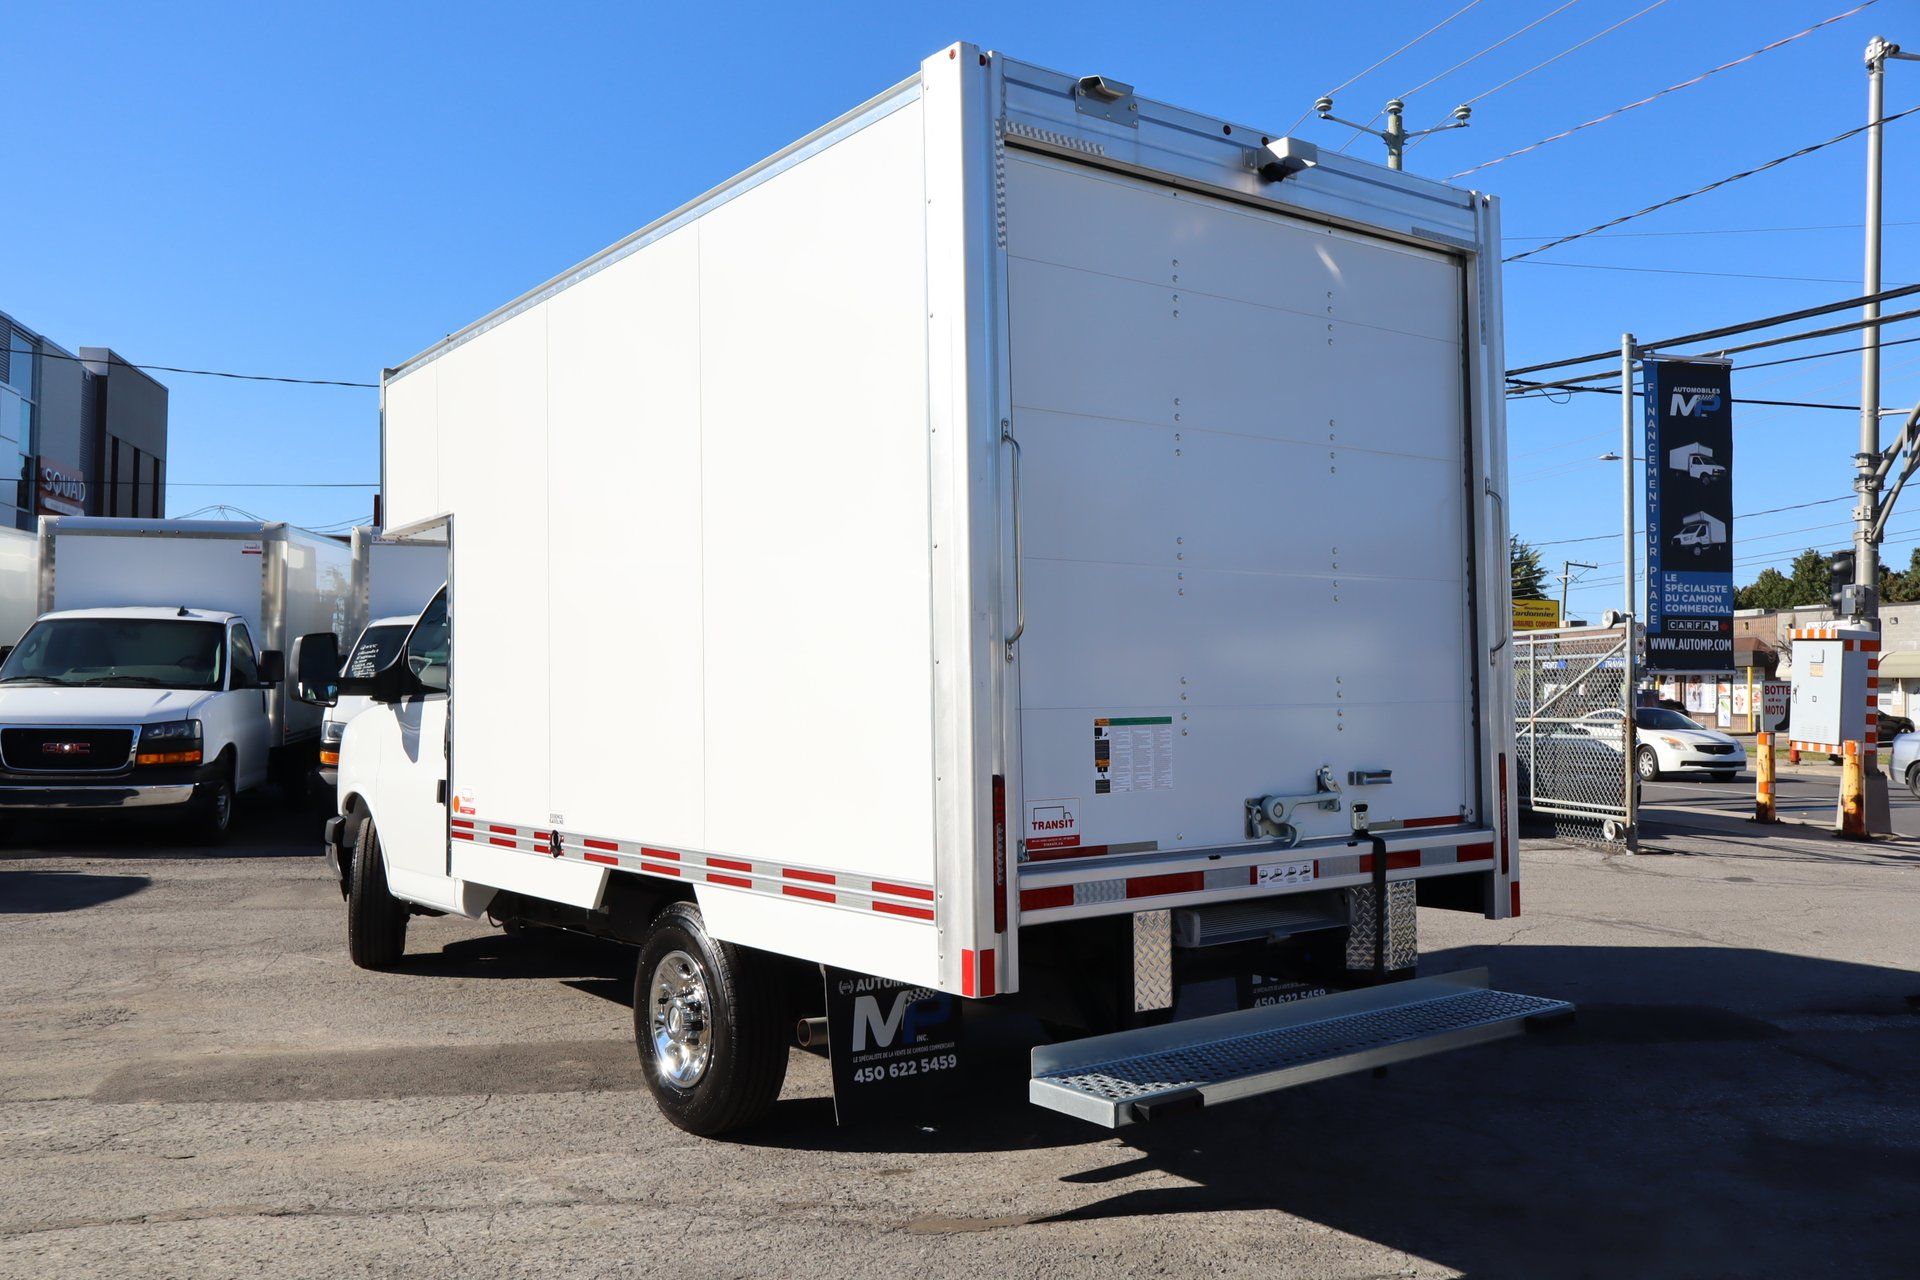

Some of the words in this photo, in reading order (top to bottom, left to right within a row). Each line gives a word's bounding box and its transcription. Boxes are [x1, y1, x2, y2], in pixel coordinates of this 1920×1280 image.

[1673, 386, 1720, 394] AUTOMOBILES
[1669, 393, 1721, 416] MP
[1647, 383, 1657, 512] FINANCEMENT
[44, 468, 86, 502] SQUAD
[1648, 522, 1657, 556] SUR
[1665, 573, 1677, 582] LE
[1665, 583, 1728, 593] SPÉCIALISTE
[1649, 566, 1658, 624] PLACE
[1665, 594, 1679, 602] DU
[1681, 594, 1722, 603] CAMION
[1665, 604, 1732, 613] COMMERCIAL
[1668, 620, 1719, 631] CARFAX
[1650, 637, 1732, 651] WWW.AUTOMP.COM
[1765, 705, 1785, 715] MOTO
[43, 743, 90, 753] GMC
[1032, 819, 1074, 831] TRANSIT
[854, 1065, 885, 1083] 450
[889, 1060, 918, 1078] 622
[921, 1054, 957, 1073] 5459
